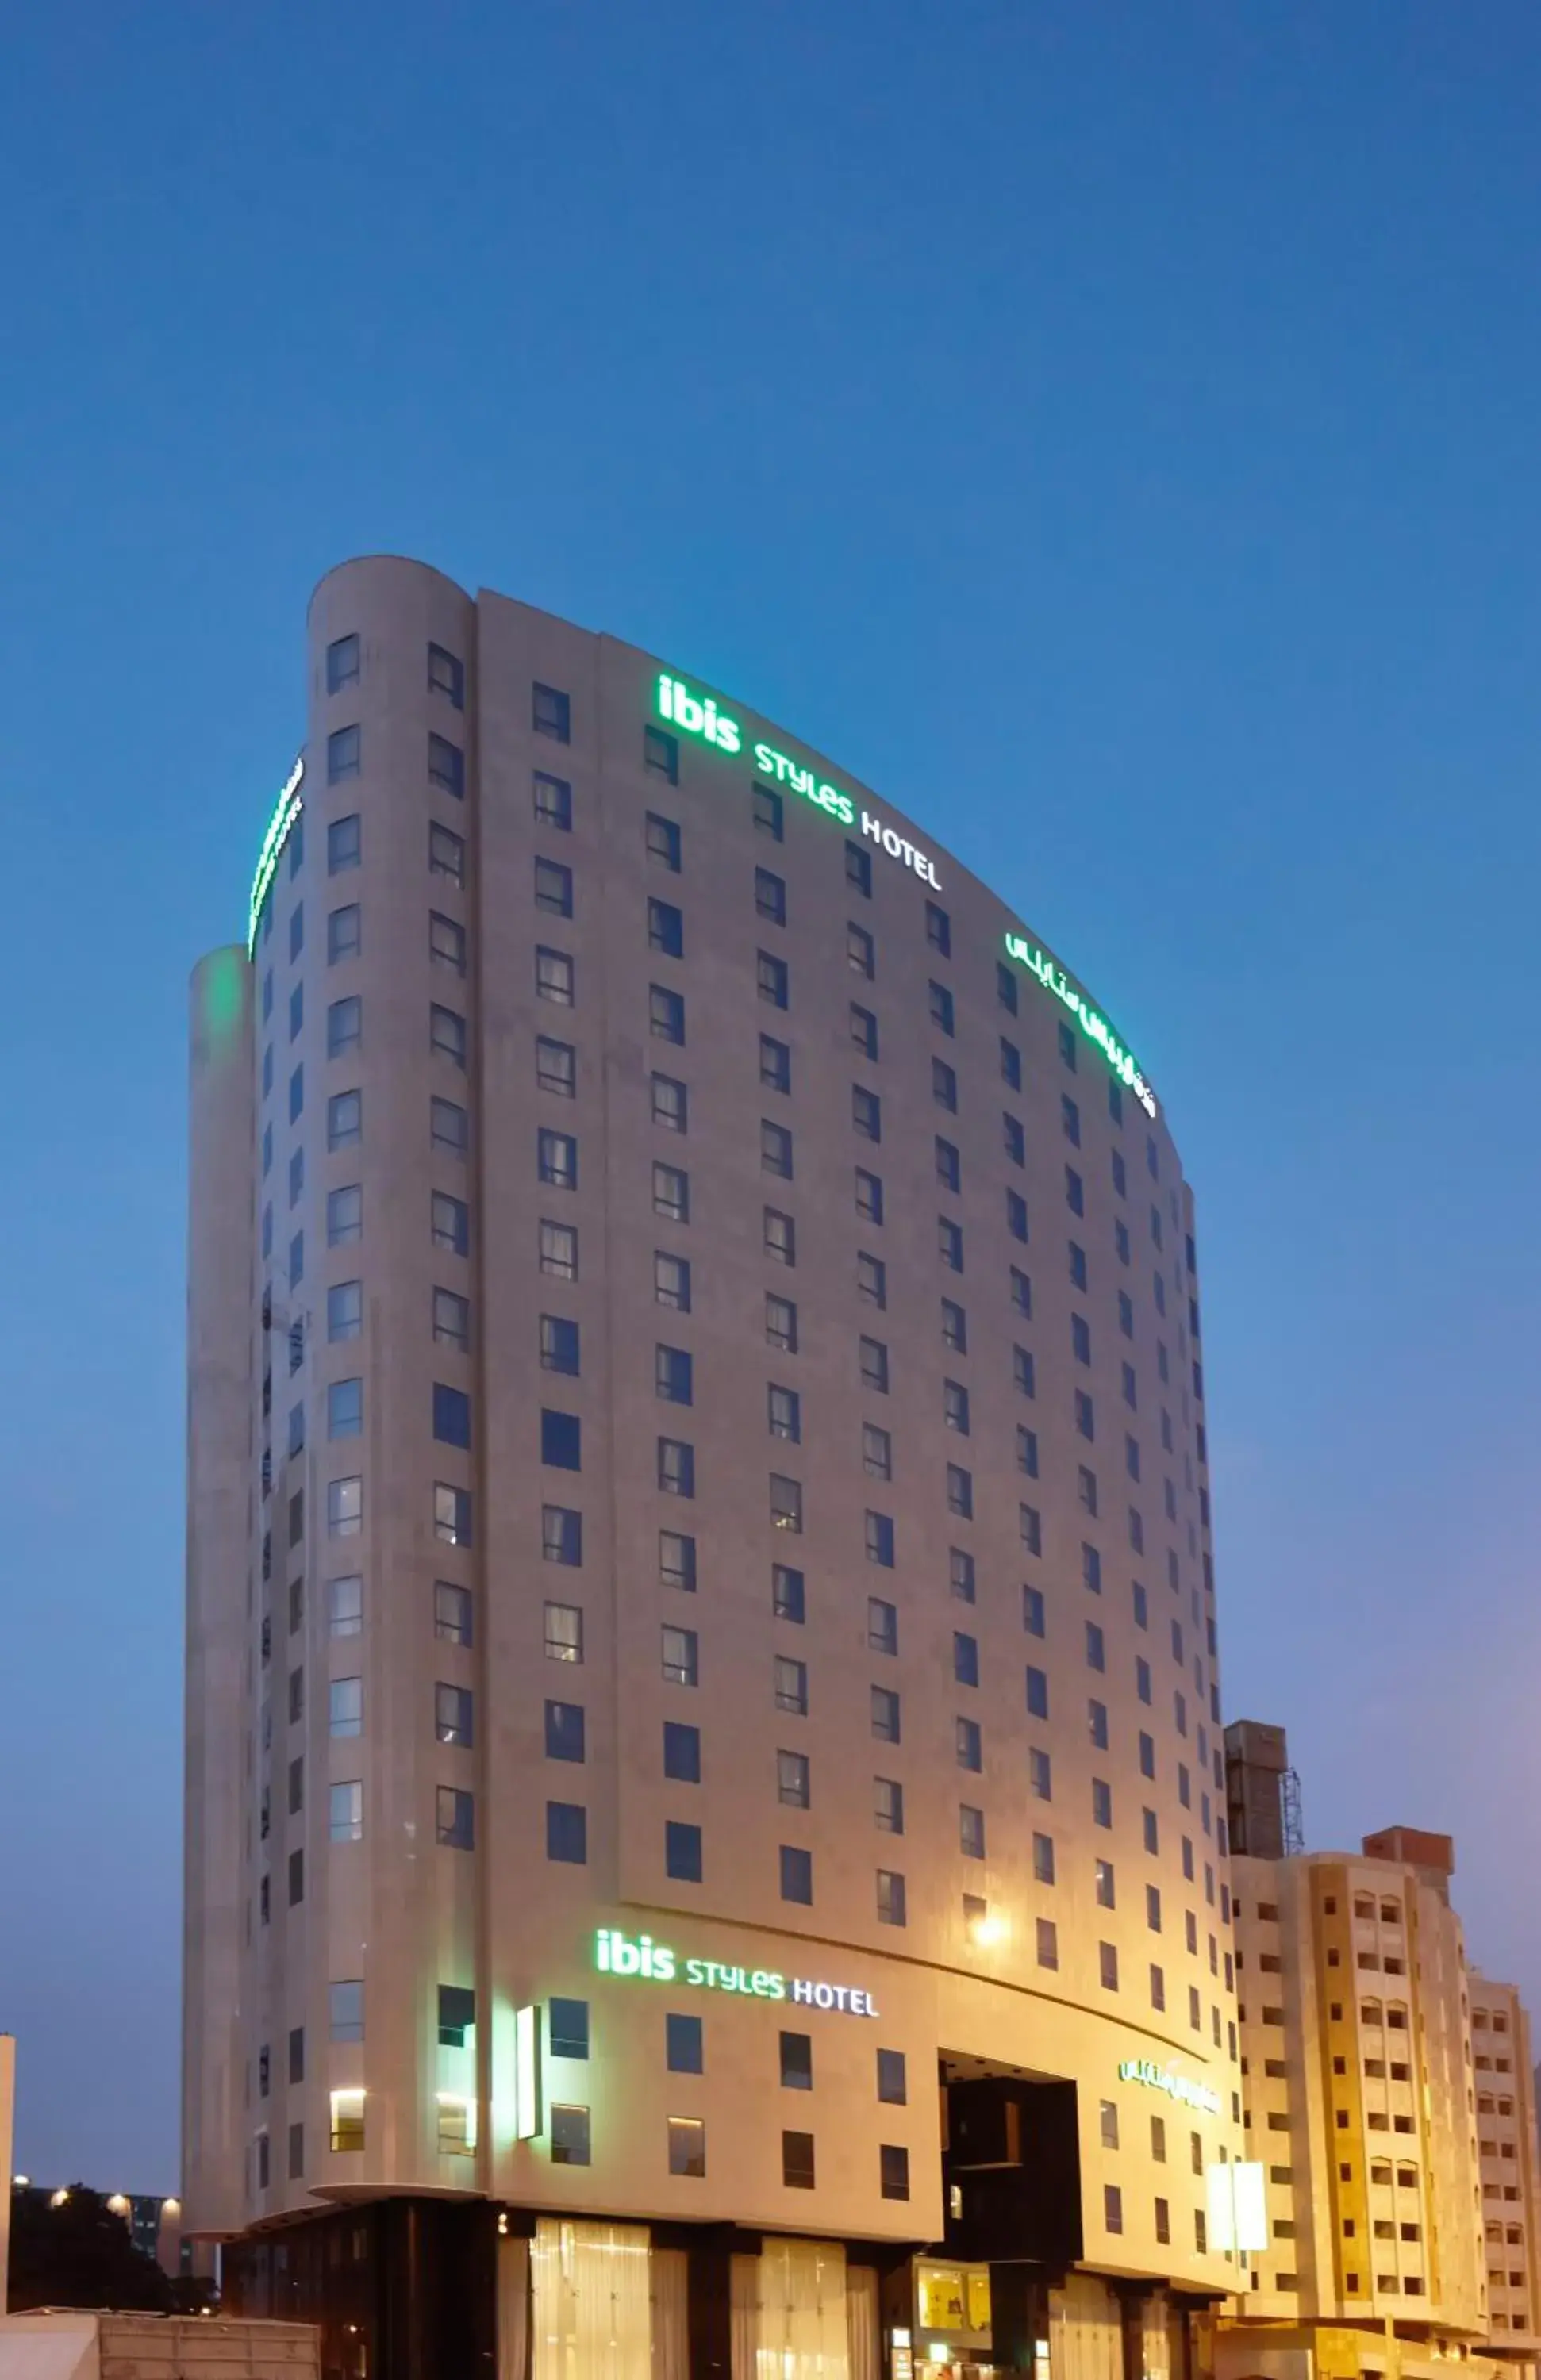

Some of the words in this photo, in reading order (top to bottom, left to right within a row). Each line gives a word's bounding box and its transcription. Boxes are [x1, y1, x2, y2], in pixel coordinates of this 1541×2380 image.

[659, 674, 740, 752] ibis
[861, 812, 943, 891] HOTEL
[597, 1929, 675, 1980] ibis
[794, 1979, 879, 2017] HOTEL
